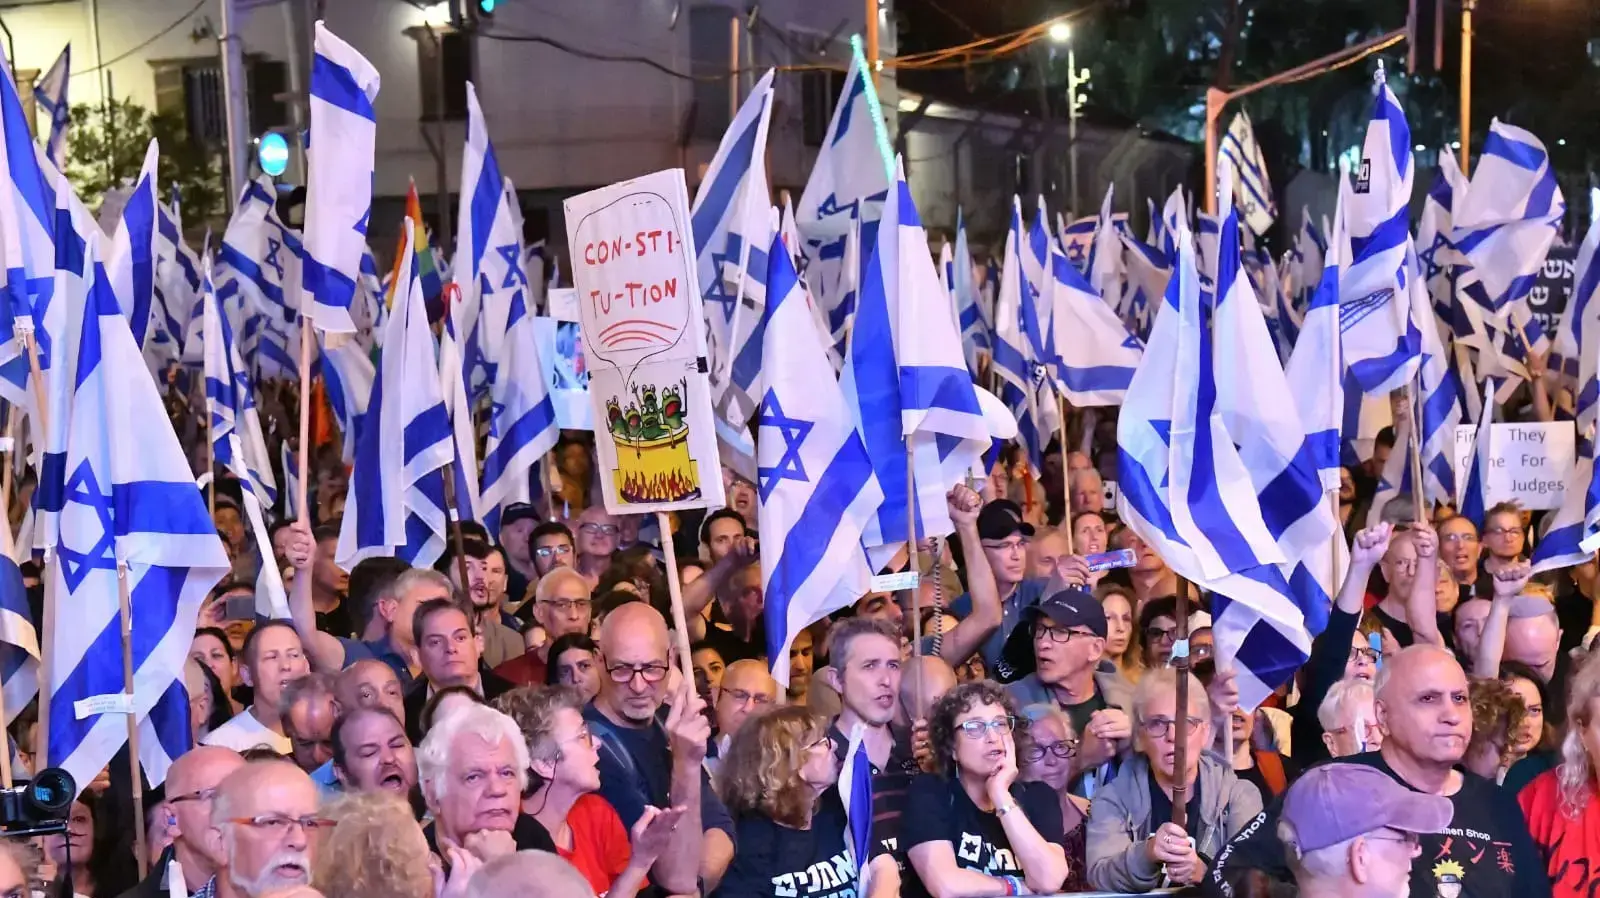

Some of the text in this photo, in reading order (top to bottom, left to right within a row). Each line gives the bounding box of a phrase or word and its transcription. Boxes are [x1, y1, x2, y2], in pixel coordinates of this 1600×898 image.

[590, 277, 677, 319] TU-TION
[1456, 428, 1547, 444] Fir They
[1521, 454, 1547, 467] For
[1440, 827, 1491, 842] men Shop
[771, 849, 858, 898] אמנים
